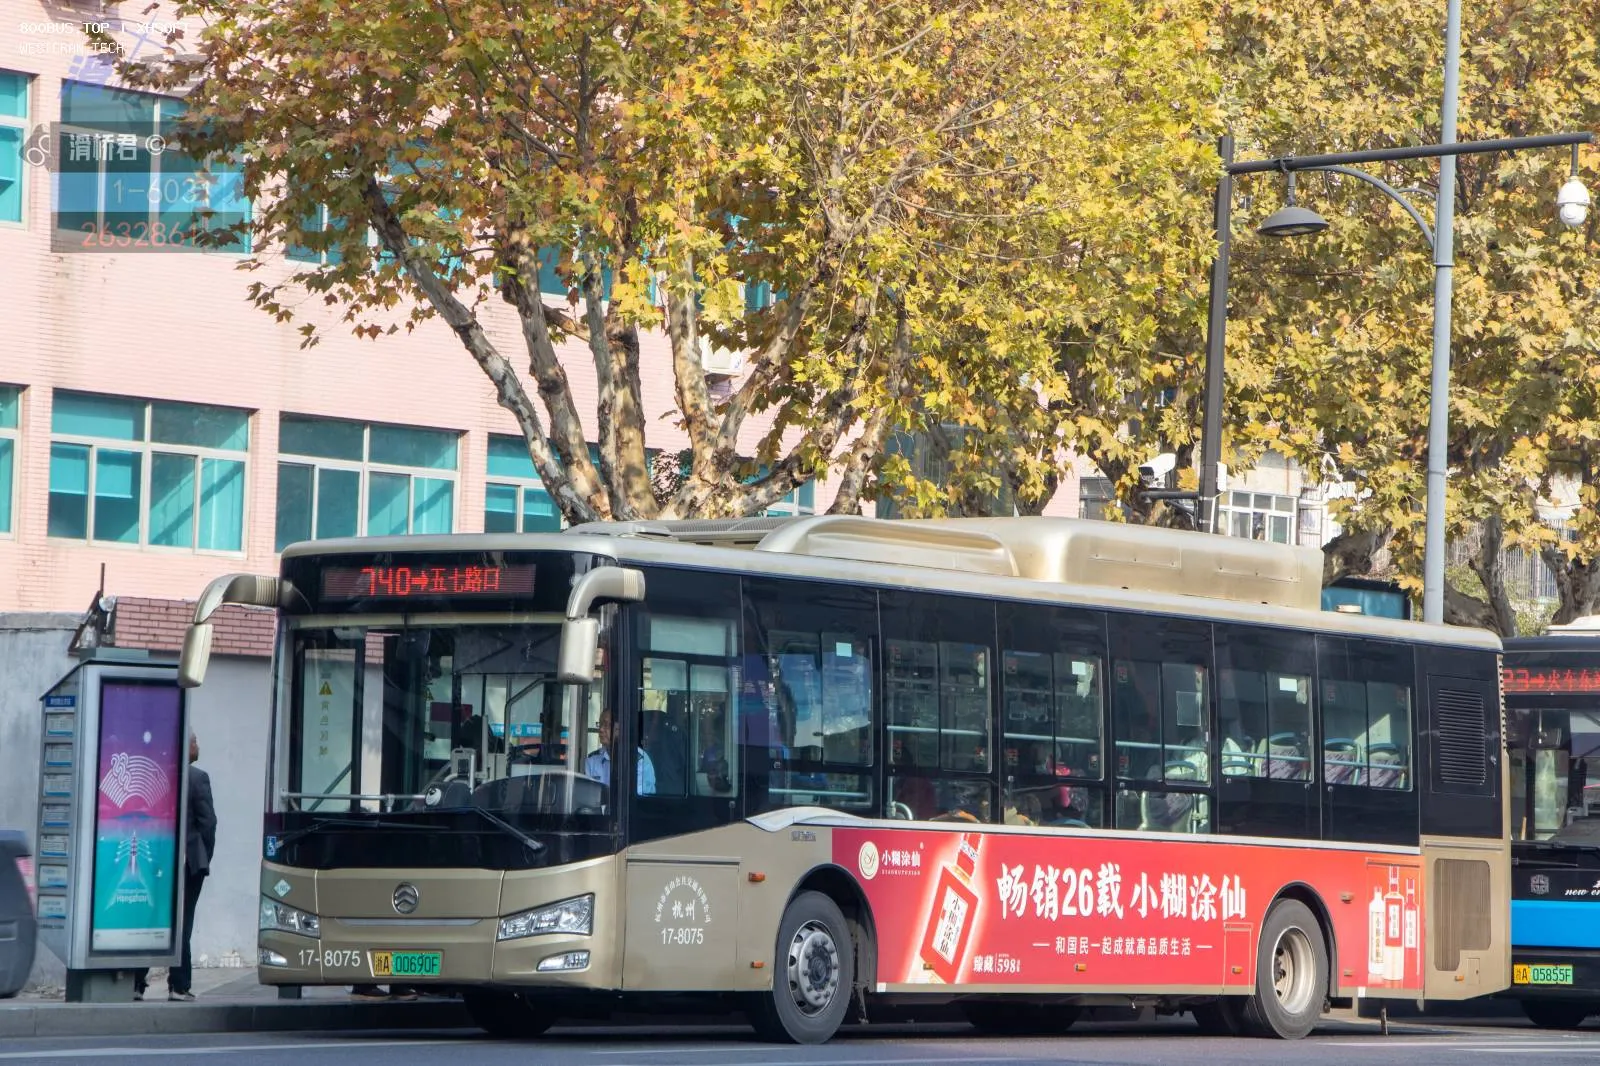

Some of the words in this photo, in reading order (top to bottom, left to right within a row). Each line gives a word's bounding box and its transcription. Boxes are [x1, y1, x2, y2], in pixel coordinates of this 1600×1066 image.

[361, 567, 411, 596] 740
[881, 850, 921, 867] 小糊涂仙
[996, 862, 1125, 922] 畅销26载
[1130, 872, 1247, 922] 小糊涂仙
[661, 927, 704, 945] 17-8075
[1055, 936, 1192, 956] 和国民一起成就高品质生活
[299, 950, 361, 967] 17-8075
